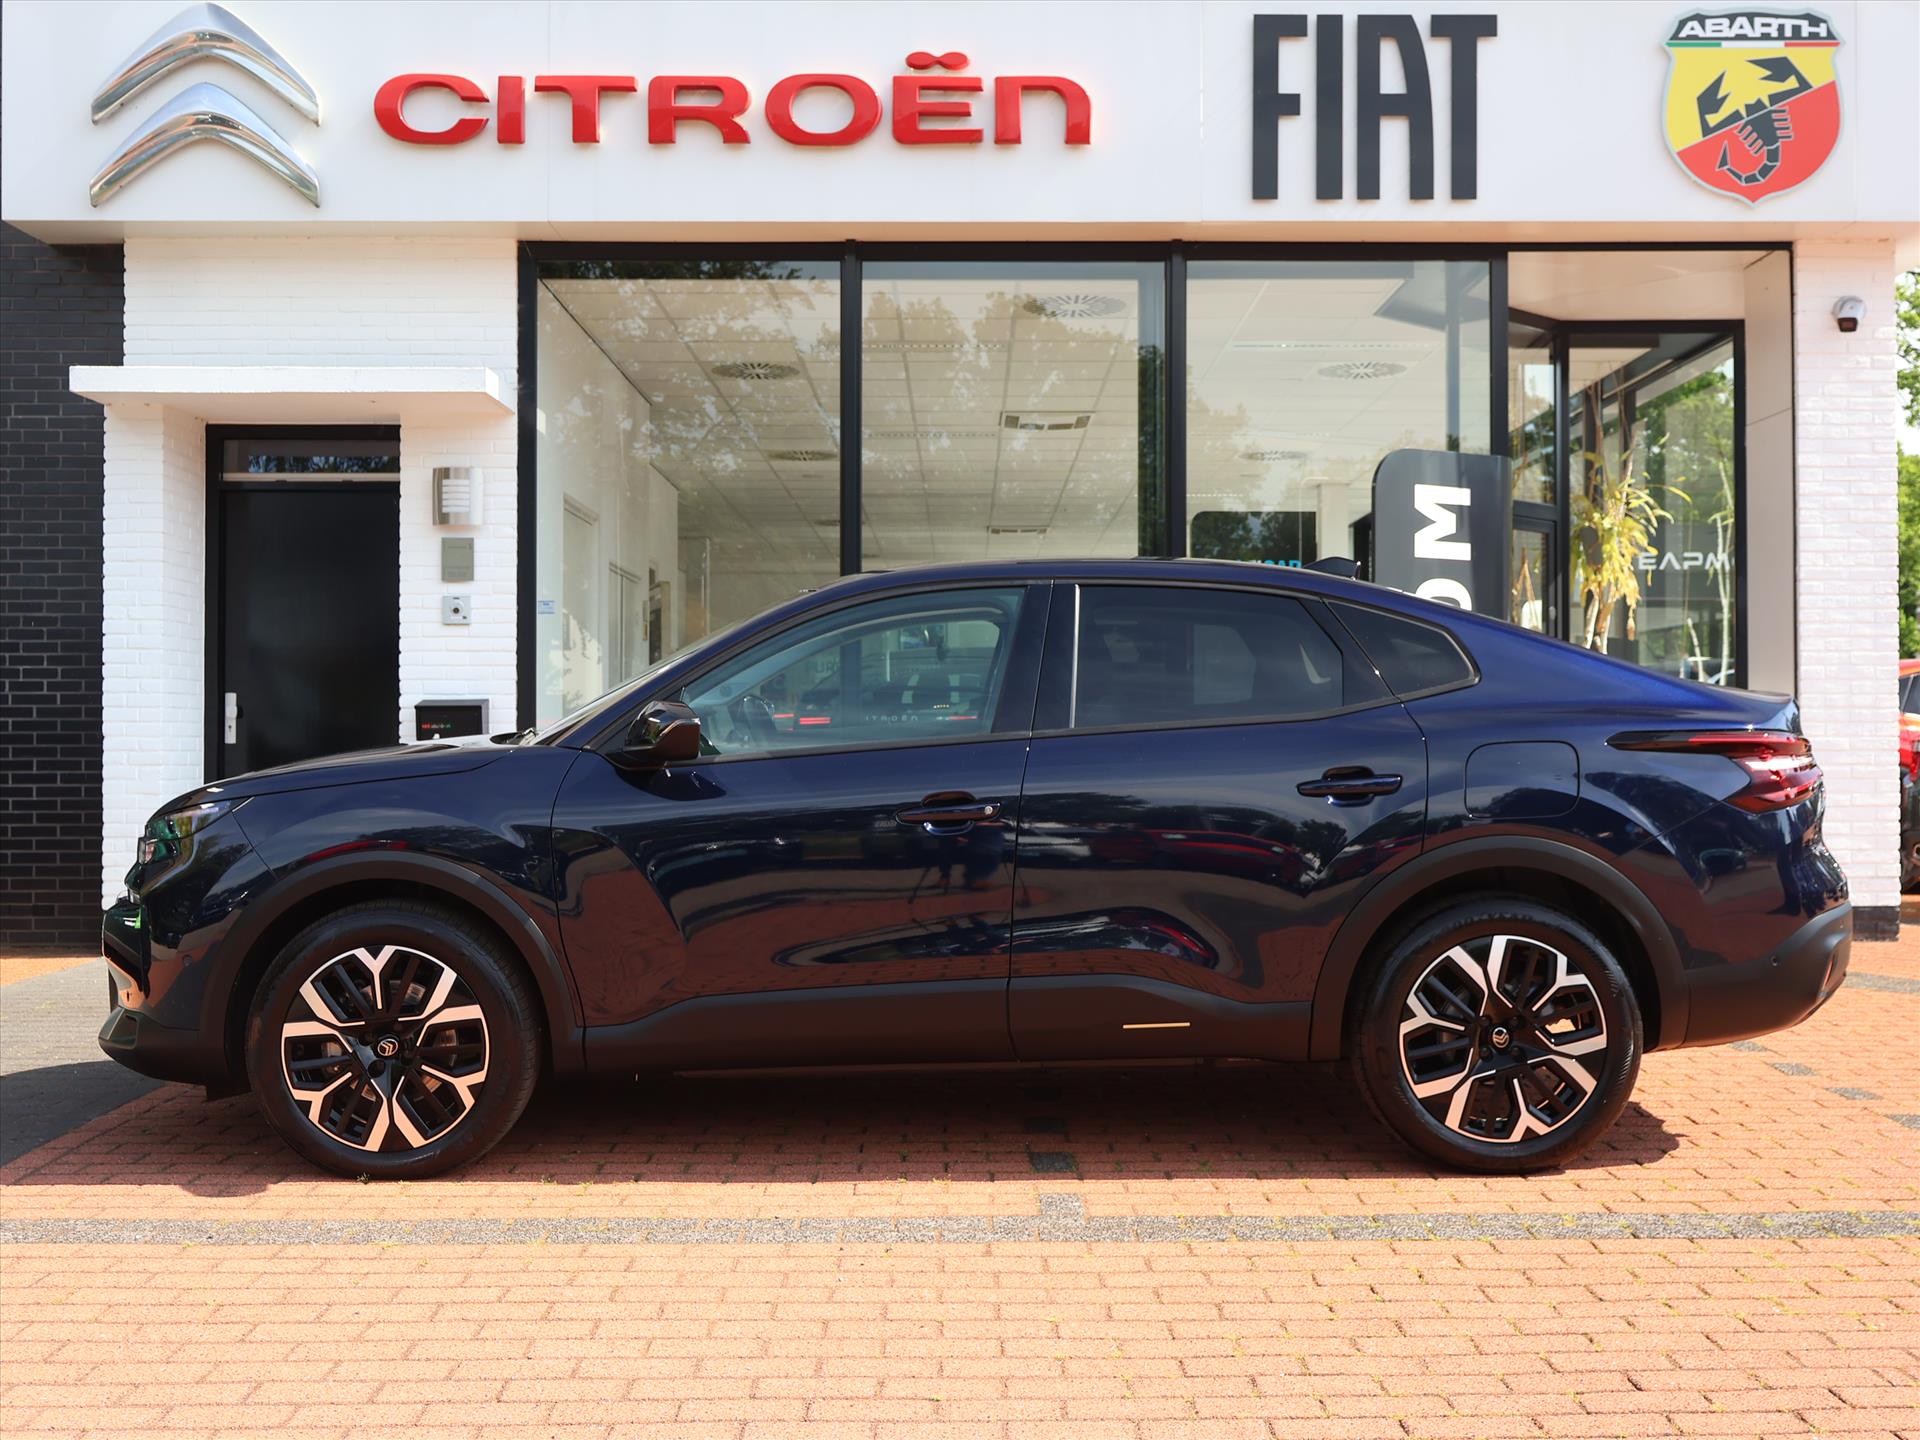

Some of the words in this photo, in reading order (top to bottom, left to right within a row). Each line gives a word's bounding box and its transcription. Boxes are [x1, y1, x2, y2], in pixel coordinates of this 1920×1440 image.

[1678, 16, 1828, 38] ABARTH
[374, 52, 1092, 148] CITROËN
[1253, 15, 1497, 200] FIAT
